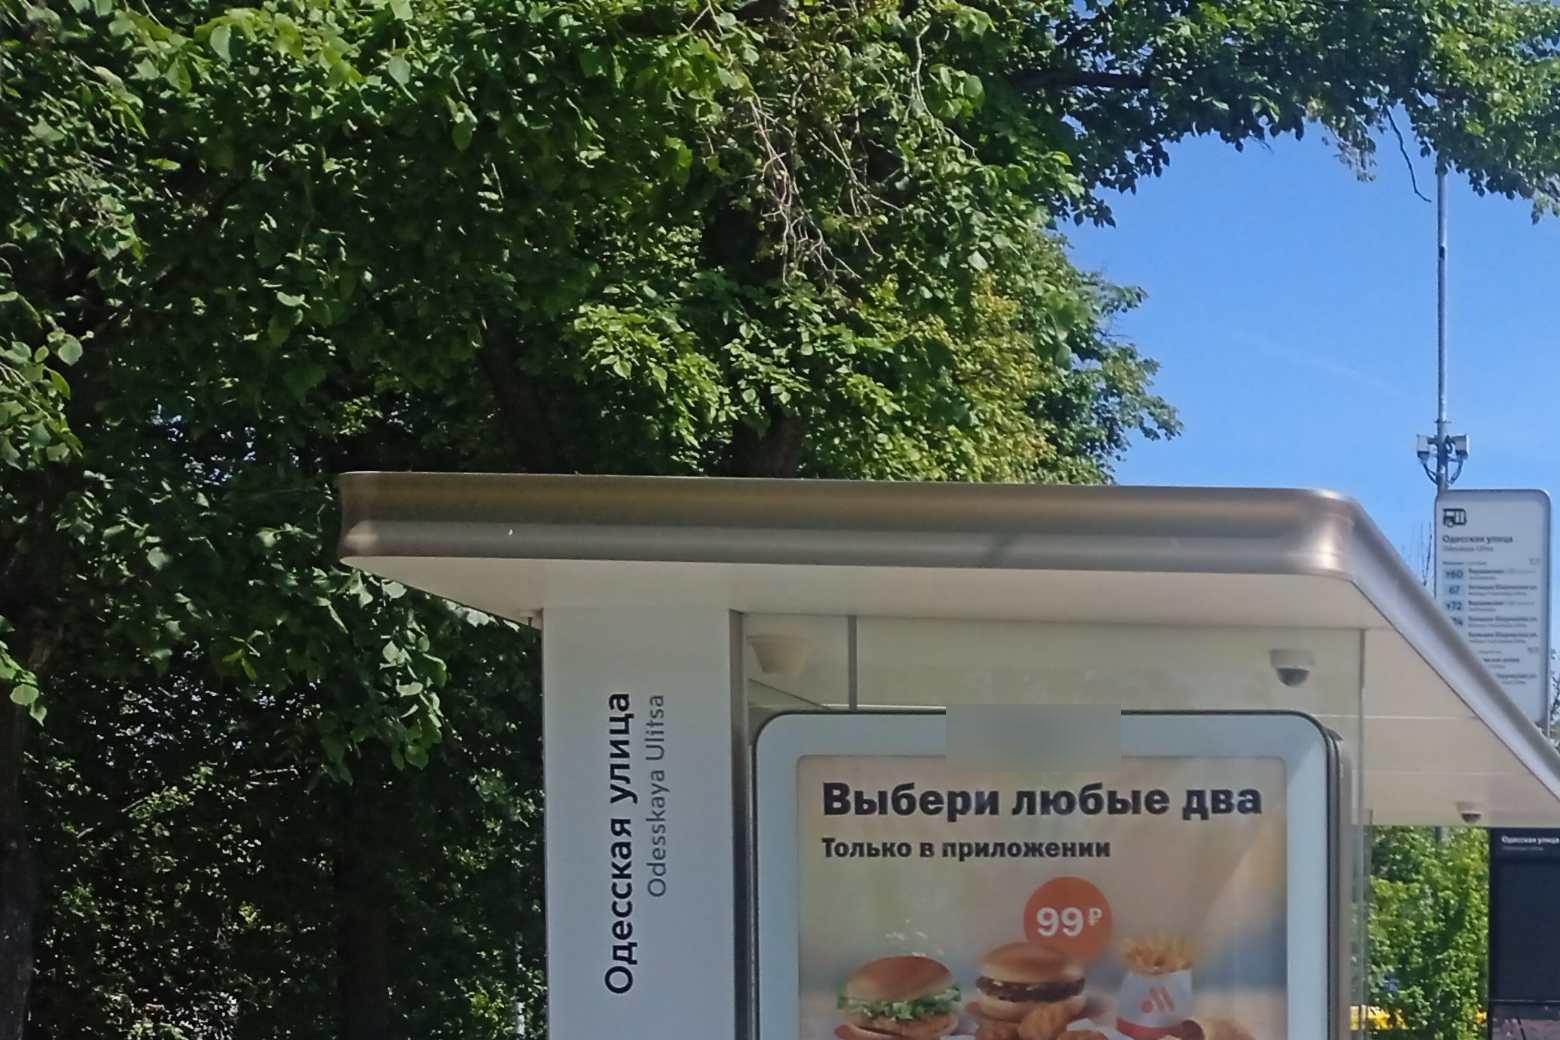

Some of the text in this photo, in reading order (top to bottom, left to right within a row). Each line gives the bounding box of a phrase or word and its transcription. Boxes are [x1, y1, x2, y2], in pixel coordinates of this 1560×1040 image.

[604, 693, 638, 994] Одесская улица
[645, 695, 670, 897] Odesskaya Ulitsa
[821, 837, 1111, 863] Только в приложении
[822, 781, 1263, 823] Выбери любые два
